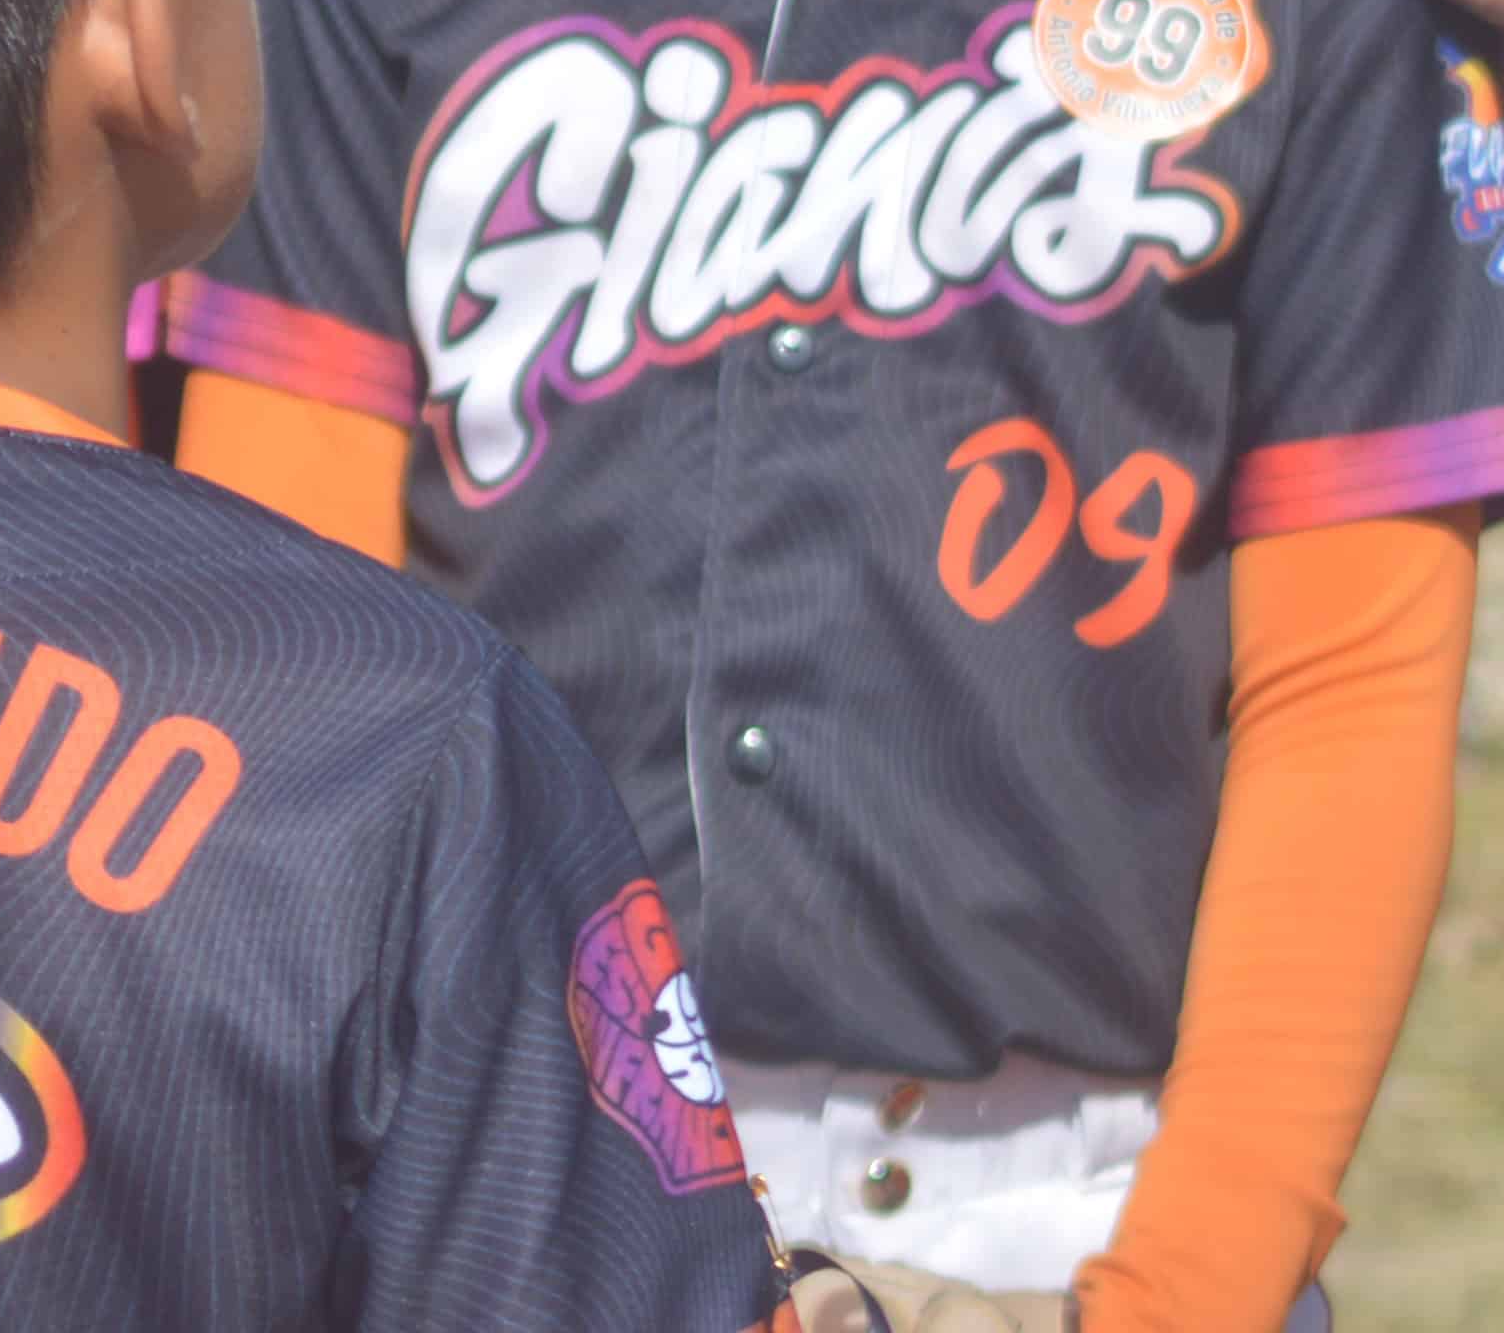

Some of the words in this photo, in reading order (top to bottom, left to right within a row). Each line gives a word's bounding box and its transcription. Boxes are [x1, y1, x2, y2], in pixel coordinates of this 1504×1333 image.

[1214, 11, 1241, 40] de
[404, 18, 1236, 503] Giants
[936, 416, 1198, 649] 09
